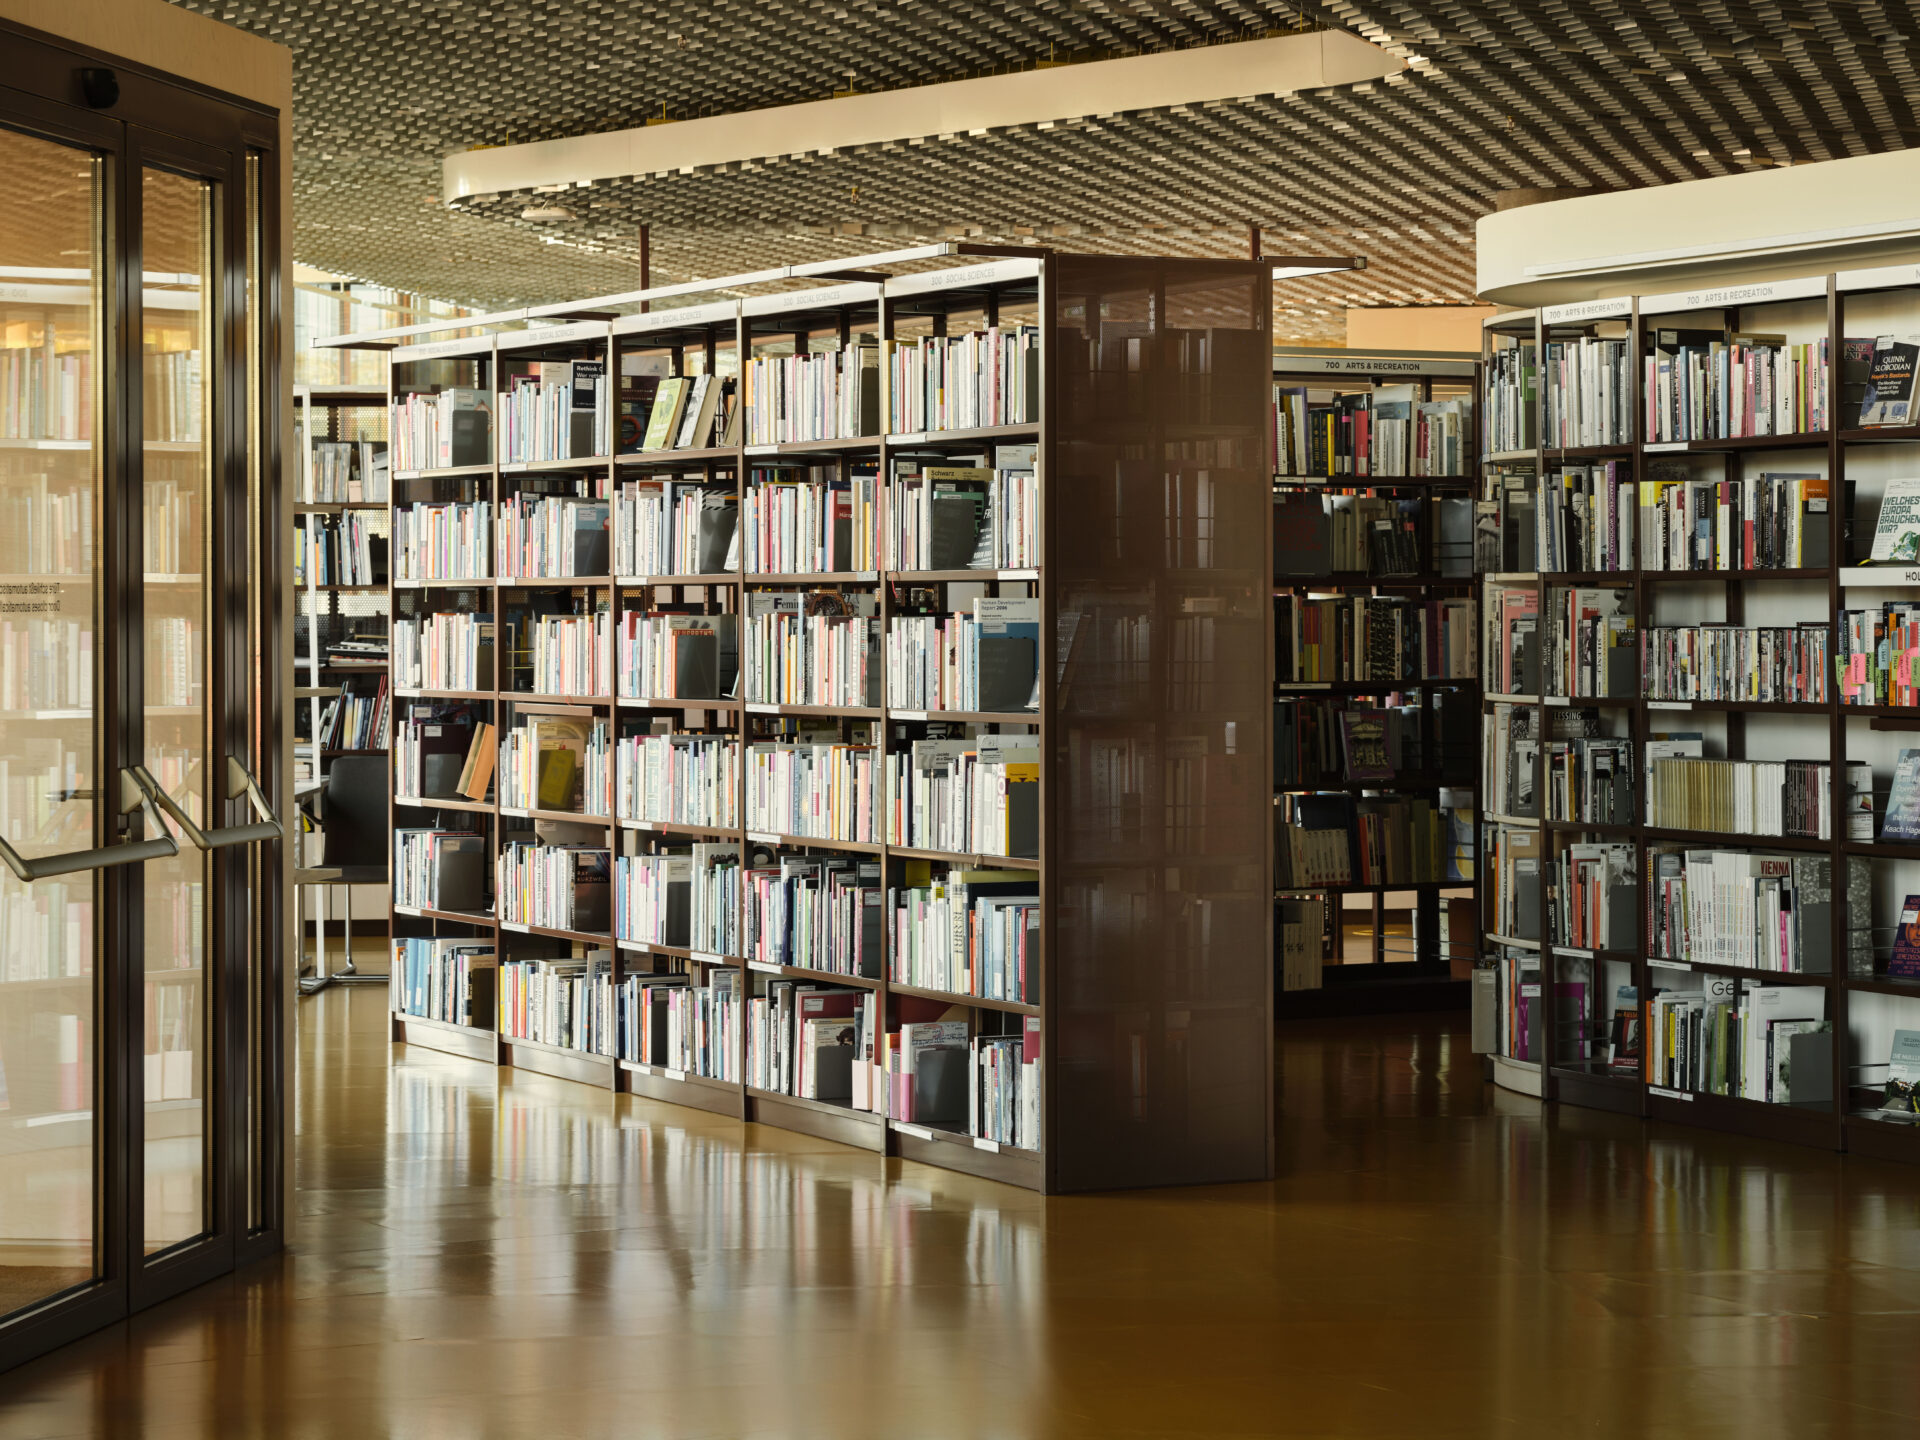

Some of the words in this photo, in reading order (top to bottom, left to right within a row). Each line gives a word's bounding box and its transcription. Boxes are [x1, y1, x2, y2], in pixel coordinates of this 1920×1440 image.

[946, 272, 966, 283] SOCIAL
[968, 268, 995, 280] SCIENCES
[1687, 296, 1699, 305] 700
[1704, 292, 1722, 303] ARTS
[1723, 292, 1728, 301] &
[1729, 287, 1773, 300] RECREATION
[1549, 310, 1561, 320] 700
[1565, 307, 1580, 317] ARTS
[1587, 302, 1626, 316] RECREATION
[1882, 355, 1906, 364] QUINN
[1346, 362, 1365, 370] ARTS
[1367, 362, 1372, 370] &
[1374, 363, 1420, 371] RECREATION
[1874, 363, 1911, 372] SLOBODIAN
[1884, 496, 1920, 505] WELCHES
[1881, 506, 1911, 515] EUROPA
[1880, 514, 1920, 524] BRAUCHEN
[1878, 524, 1898, 533] WIR?
[1554, 712, 1582, 720] LESSING
